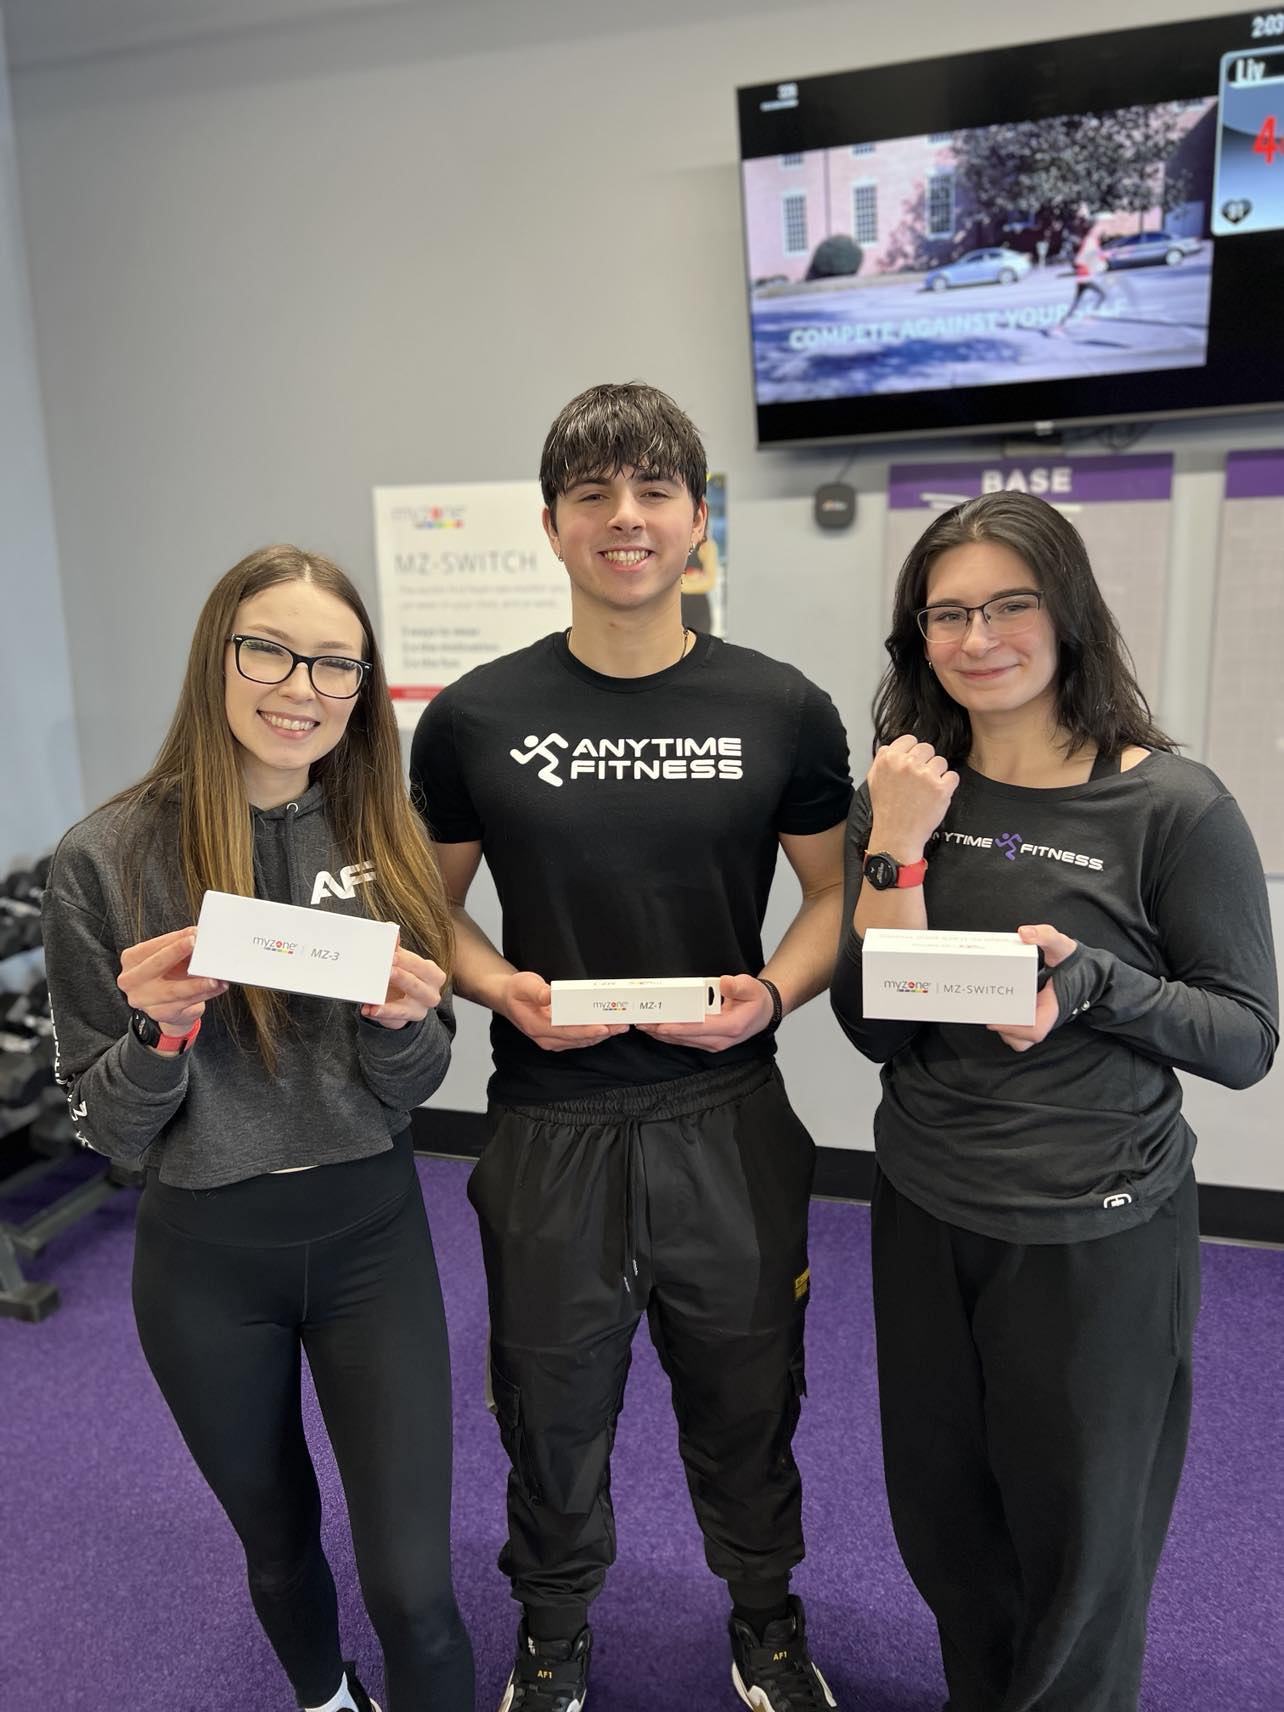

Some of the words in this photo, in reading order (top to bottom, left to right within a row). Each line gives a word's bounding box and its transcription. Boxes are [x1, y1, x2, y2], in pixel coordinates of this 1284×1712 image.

[1235, 58, 1266, 82] Liv
[788, 320, 895, 350] COMPETE
[900, 310, 998, 341] AGAINST
[1004, 297, 1128, 328] YOURLF
[981, 467, 1072, 494] BASE
[394, 549, 538, 575] MZ-SWITCH
[572, 737, 742, 758] ANYTIME
[570, 759, 744, 780] FITNESS
[1020, 843, 1104, 871] FITNESS
[253, 936, 297, 951] myzone
[310, 948, 340, 961] MZ-3
[884, 979, 930, 991] myzone
[943, 984, 1014, 995] MZ-SWITCH
[639, 1001, 662, 1010] MZ-1
[773, 1651, 787, 1661] AF1
[537, 1669, 552, 1679] AF1
